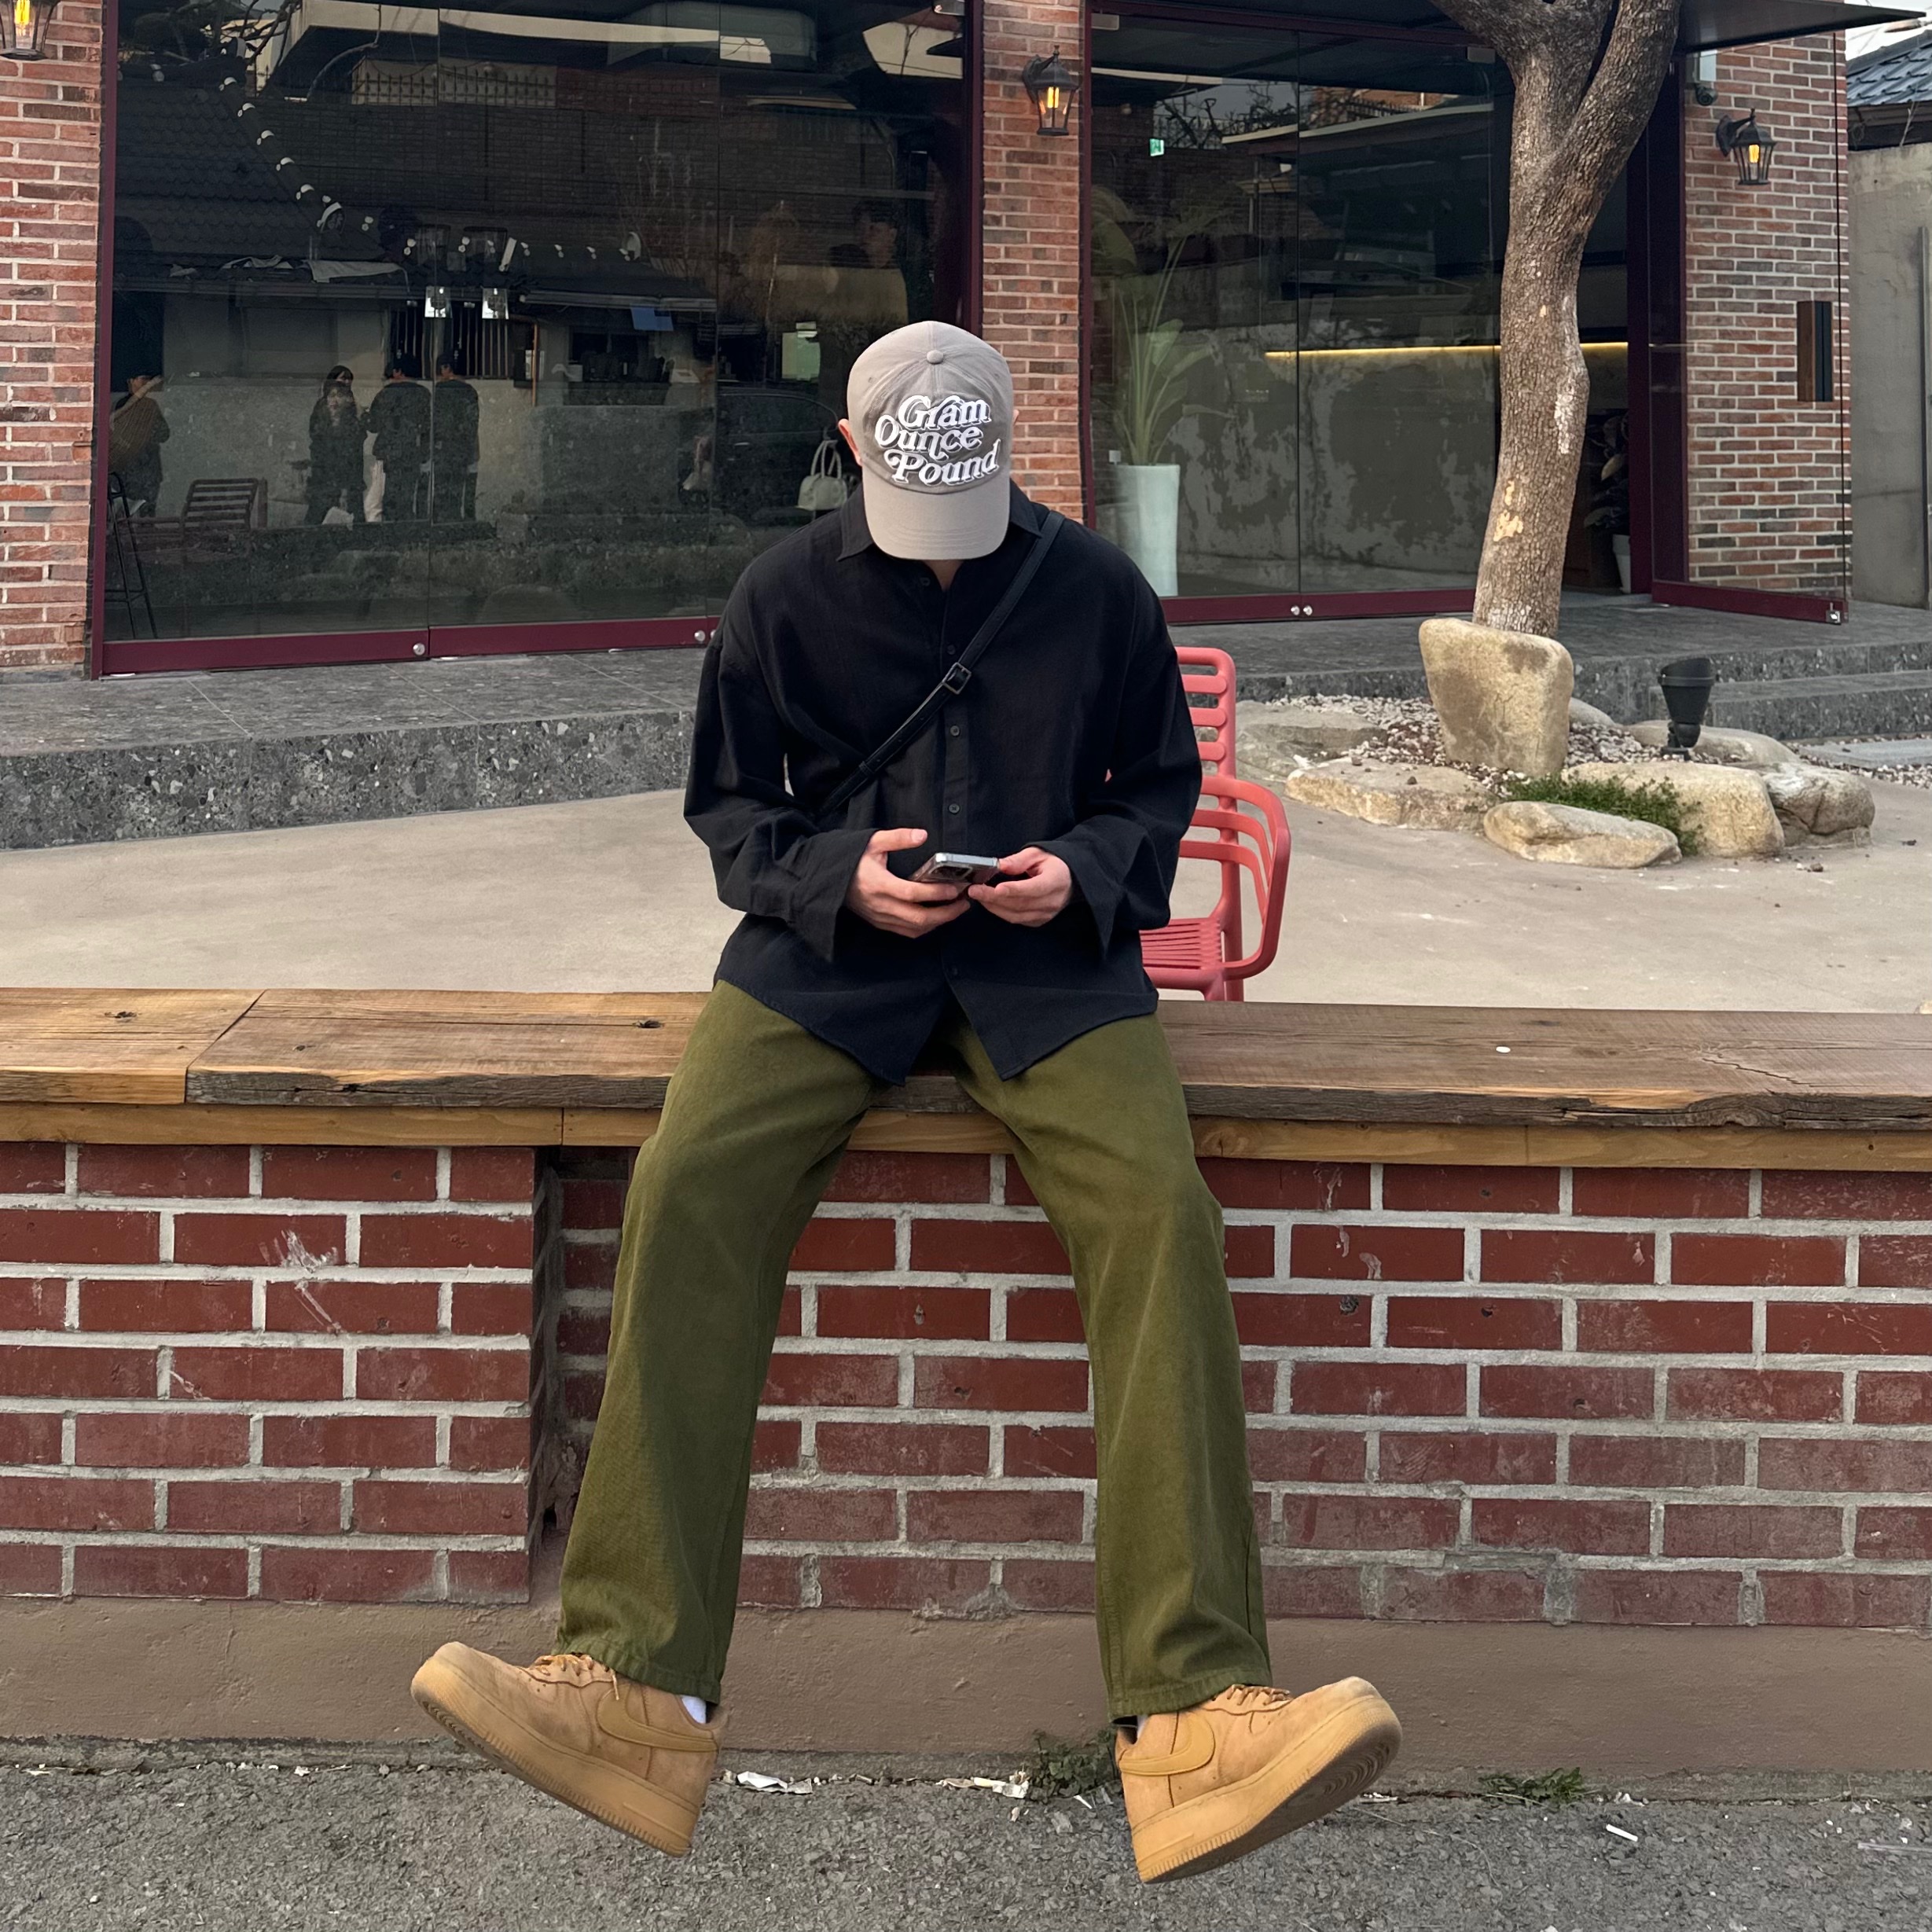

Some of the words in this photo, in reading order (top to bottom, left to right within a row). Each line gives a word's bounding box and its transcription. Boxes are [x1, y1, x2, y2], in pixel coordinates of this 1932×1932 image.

[898, 395, 991, 430] Gram
[875, 415, 983, 461] Ounce
[883, 439, 1001, 487] Pound
